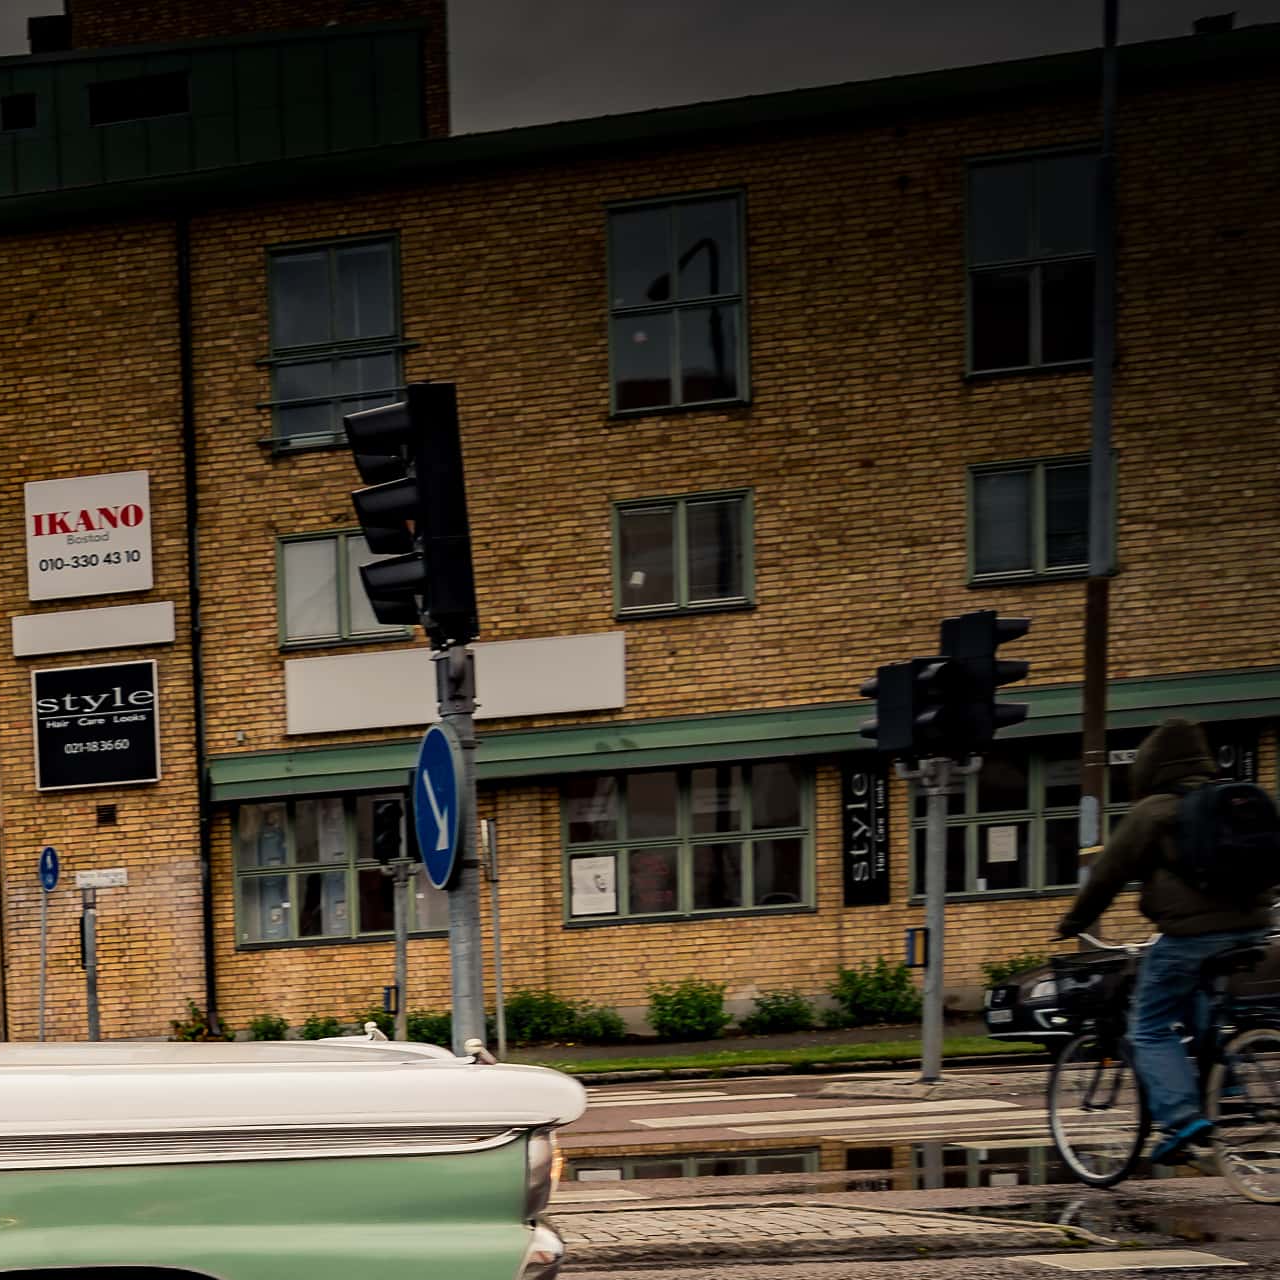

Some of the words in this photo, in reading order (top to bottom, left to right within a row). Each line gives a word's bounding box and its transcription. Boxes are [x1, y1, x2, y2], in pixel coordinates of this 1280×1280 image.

[32, 504, 144, 536] IKANO
[66, 531, 110, 545] Bostad
[39, 554, 99, 572] 010-330
[103, 551, 122, 565] 43
[124, 550, 141, 563] 10
[37, 687, 153, 713] style
[45, 720, 70, 729] Hair
[77, 717, 106, 726] Care
[112, 714, 146, 723] Looks
[846, 773, 872, 881] style
